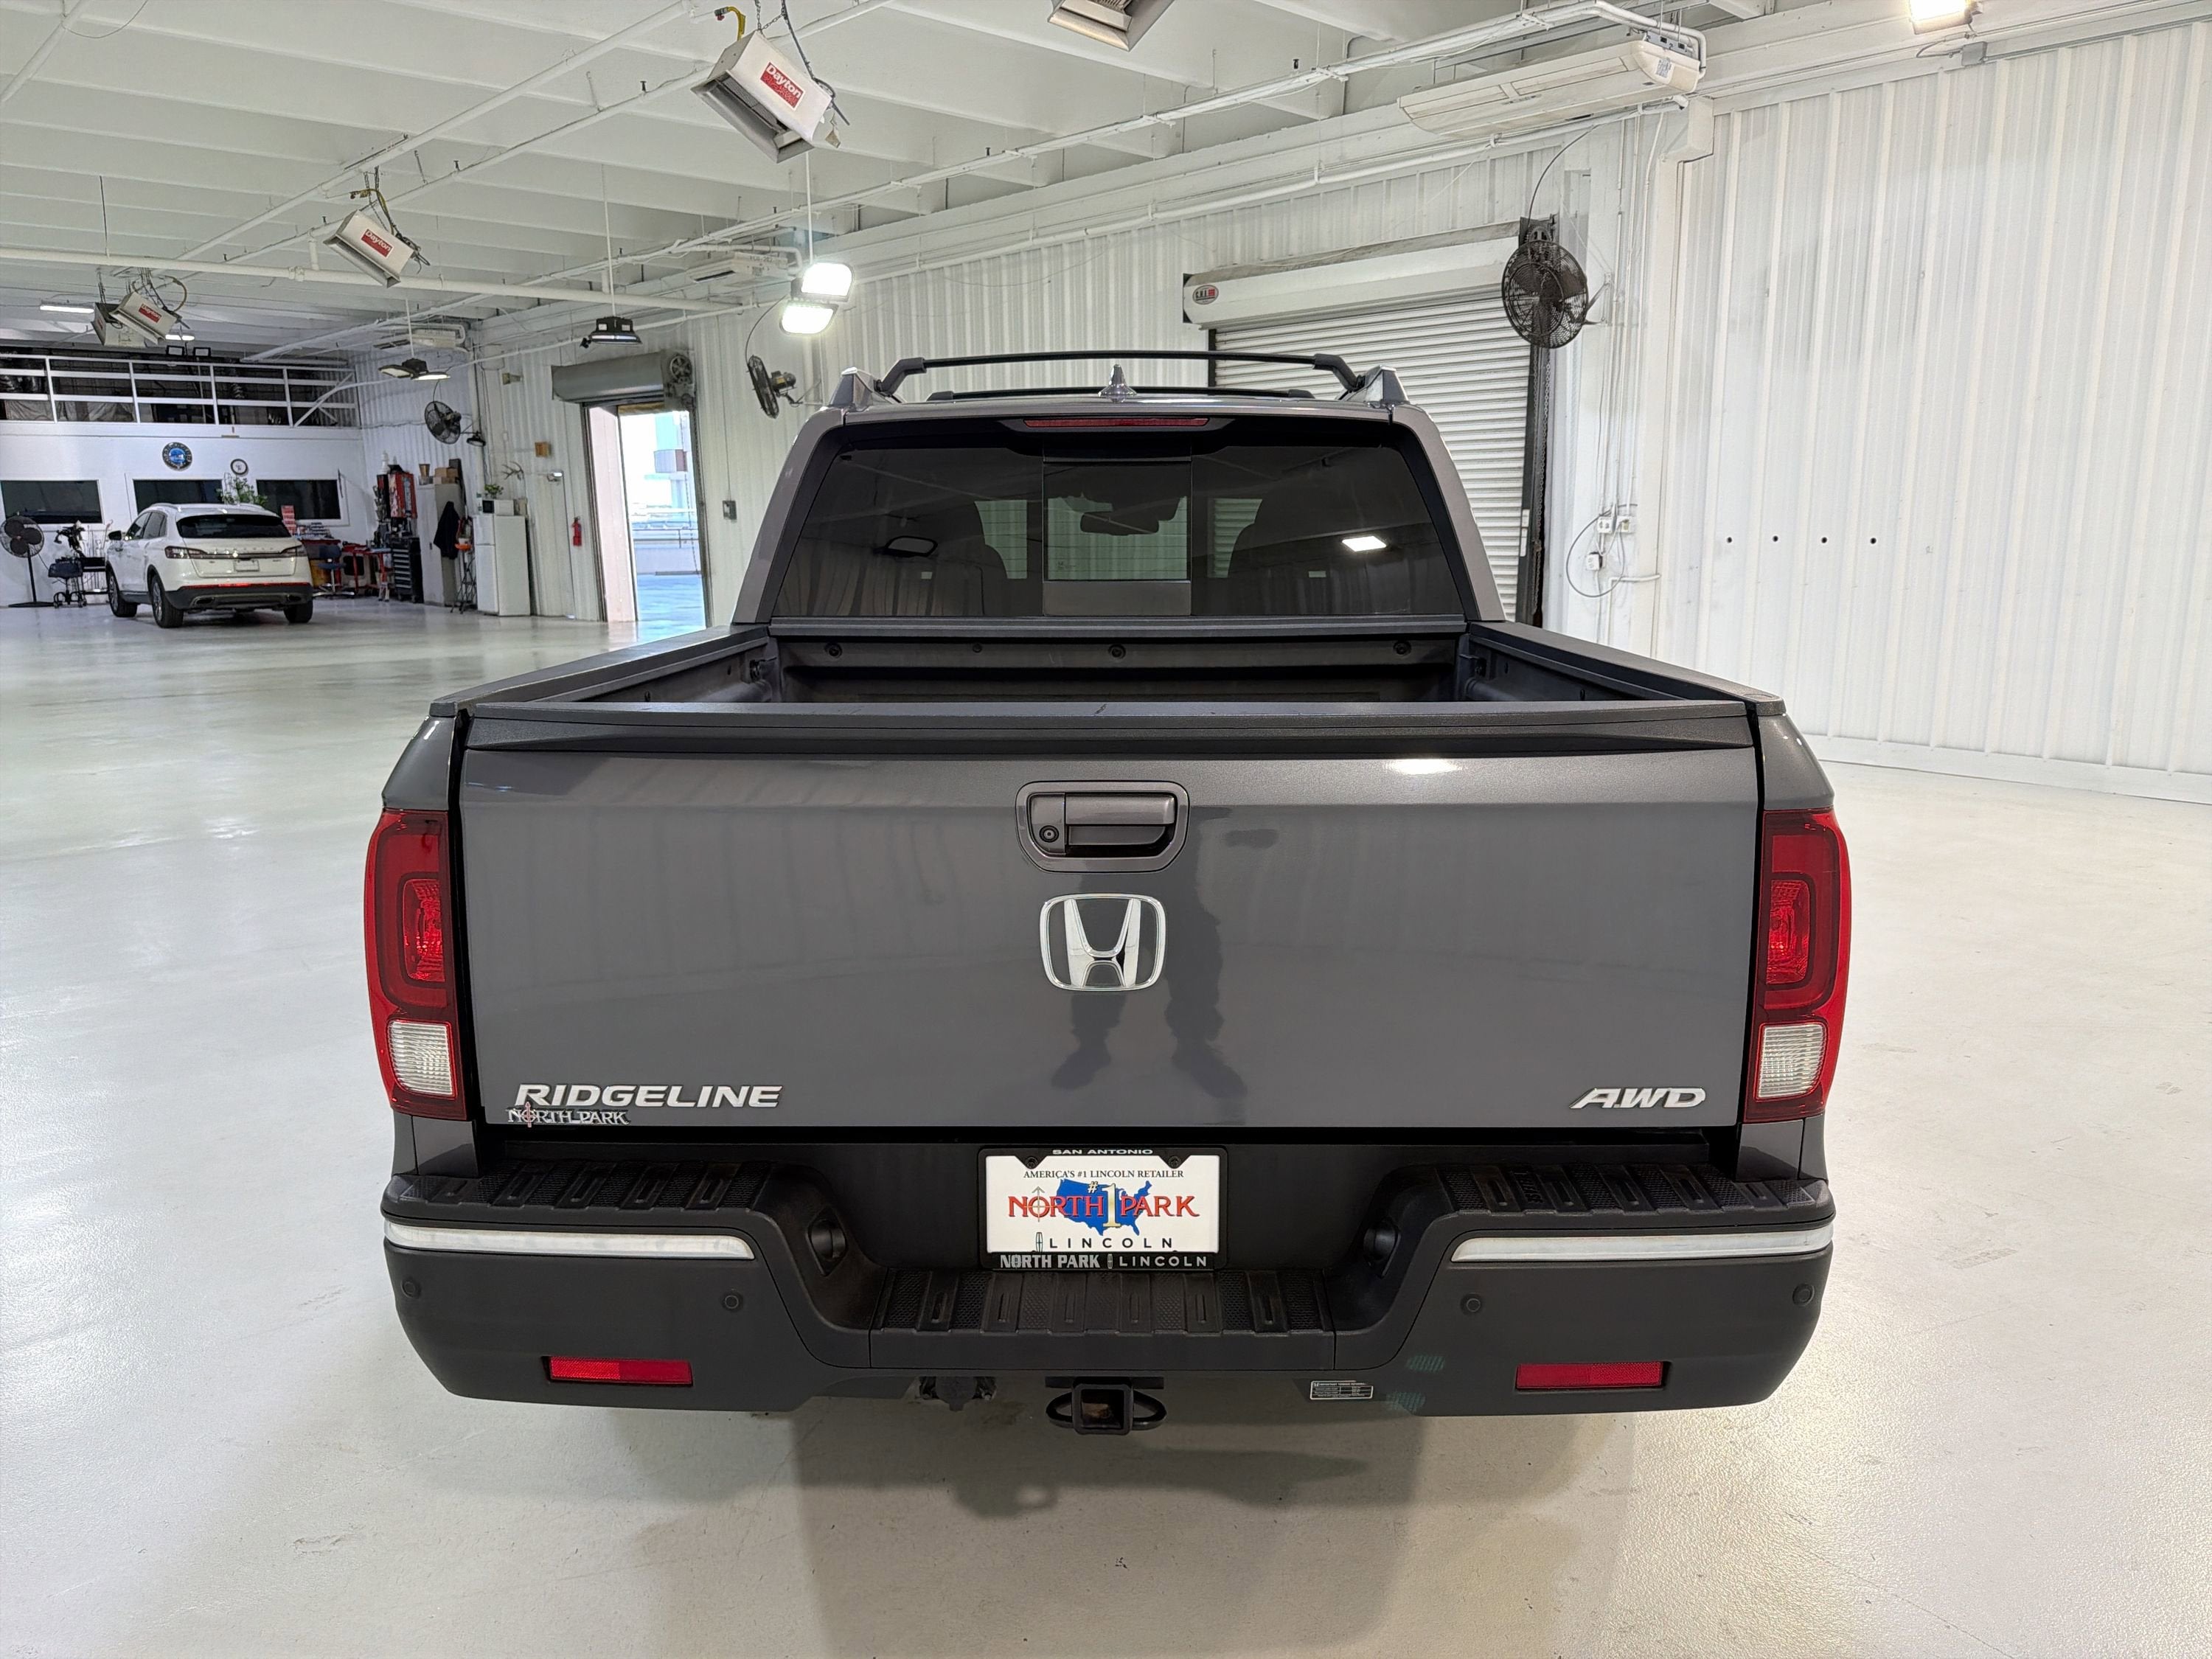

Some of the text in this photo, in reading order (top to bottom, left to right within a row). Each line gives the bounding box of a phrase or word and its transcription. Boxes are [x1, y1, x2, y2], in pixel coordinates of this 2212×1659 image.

[766, 64, 801, 99] Dayton
[365, 230, 392, 252] Dayton
[514, 1083, 783, 1108] RIDGELINE
[1568, 1088, 1706, 1109] AWD
[506, 1106, 631, 1126] NORTH PARK
[1023, 1169, 1184, 1178] AMERICA'S #1 LINCOLN RETAILER
[1008, 1195, 1104, 1218] NORTH
[1120, 1195, 1200, 1217] PARK
[1049, 1237, 1172, 1249] LINCOLN
[1000, 1254, 1207, 1268] NORTH PARK LINCOLN
